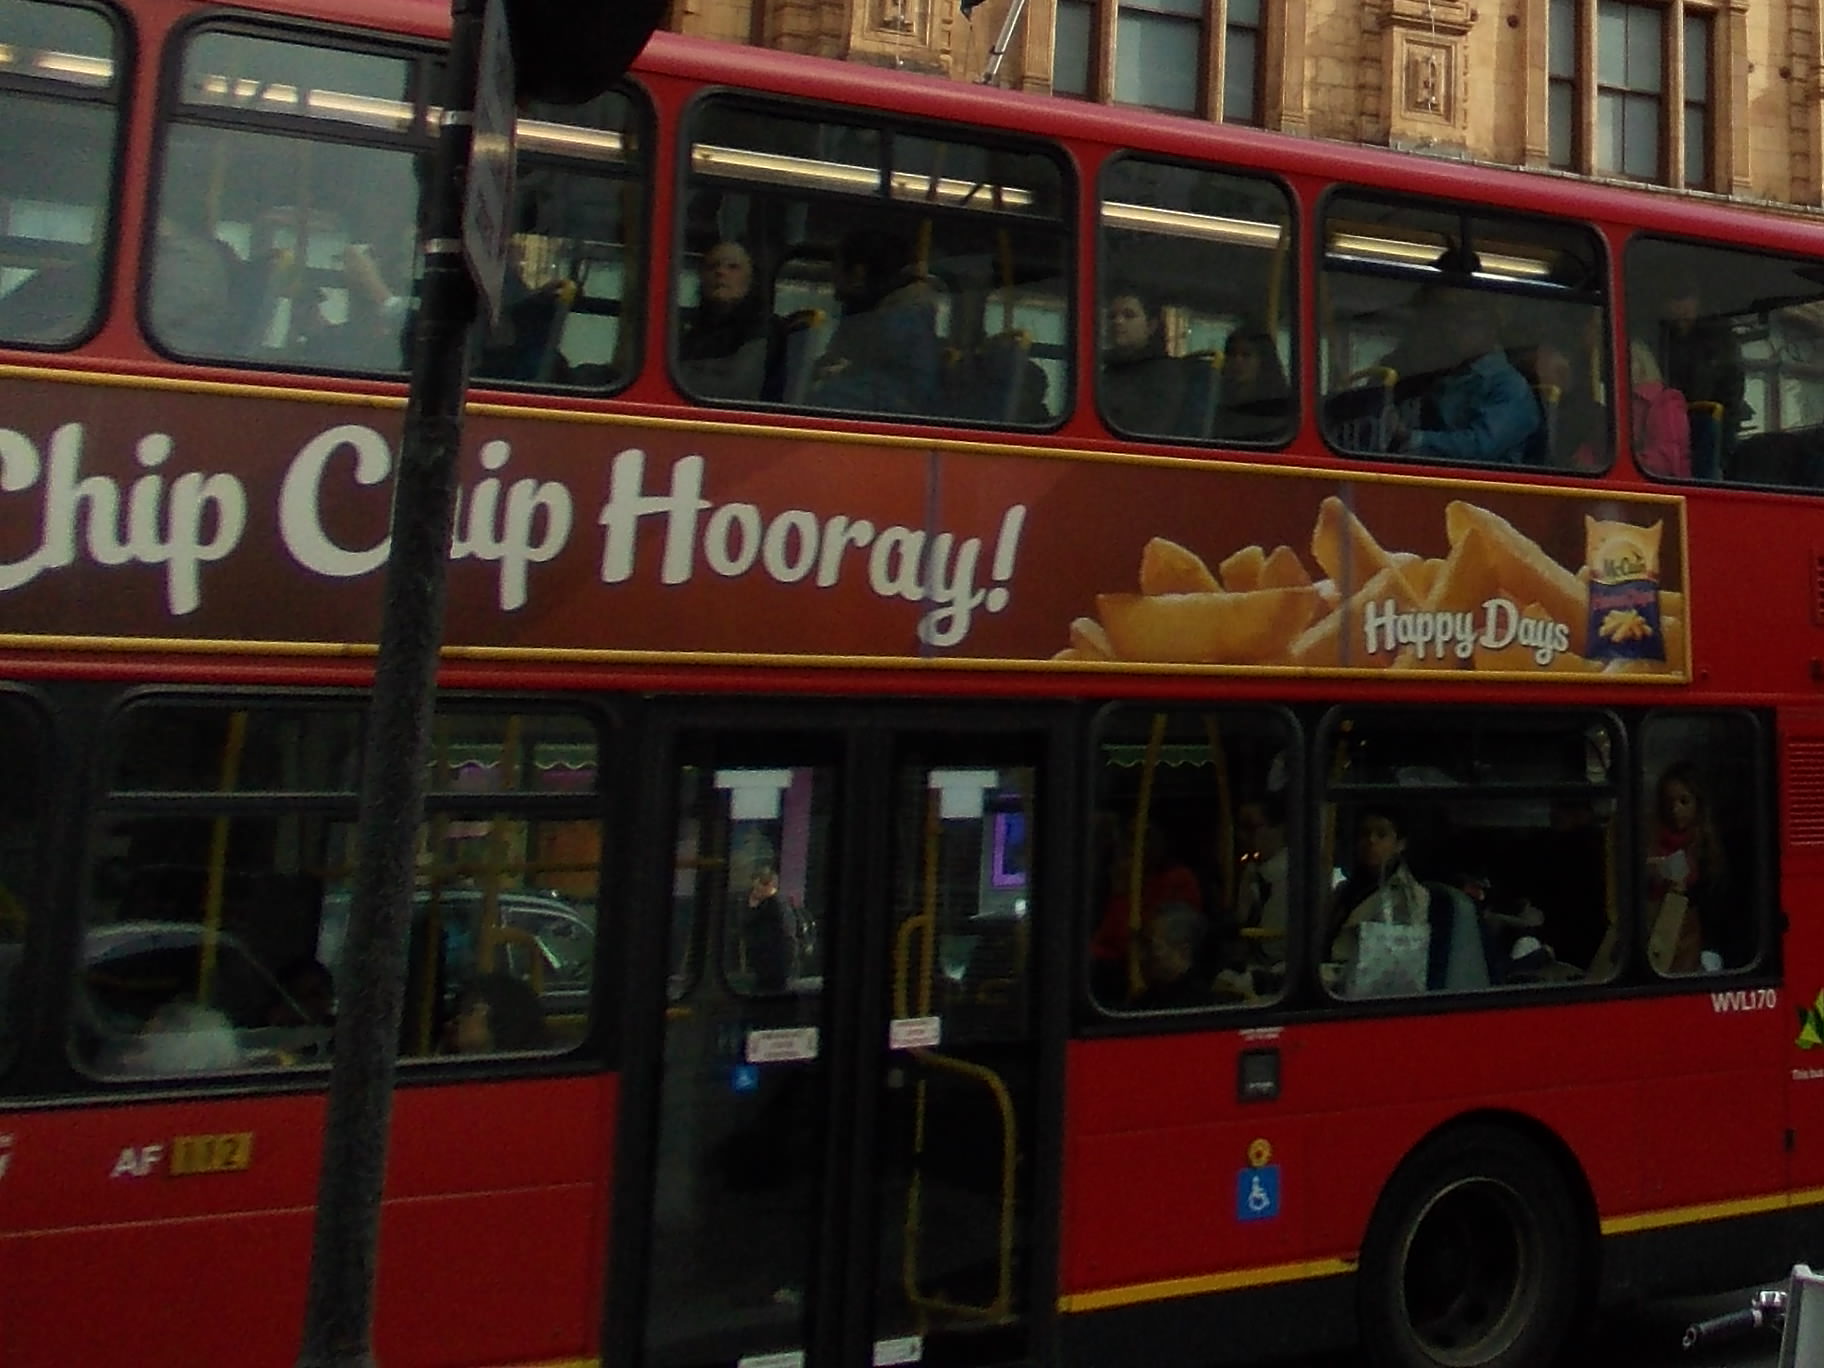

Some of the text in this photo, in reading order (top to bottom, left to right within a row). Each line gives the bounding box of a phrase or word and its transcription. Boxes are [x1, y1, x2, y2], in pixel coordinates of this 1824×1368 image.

[277, 423, 574, 612] Cip
[599, 447, 1028, 647] Hooray!
[1364, 597, 1570, 666] Happy Days
[1711, 989, 1777, 1013] WVL170
[109, 1143, 164, 1178] AF
